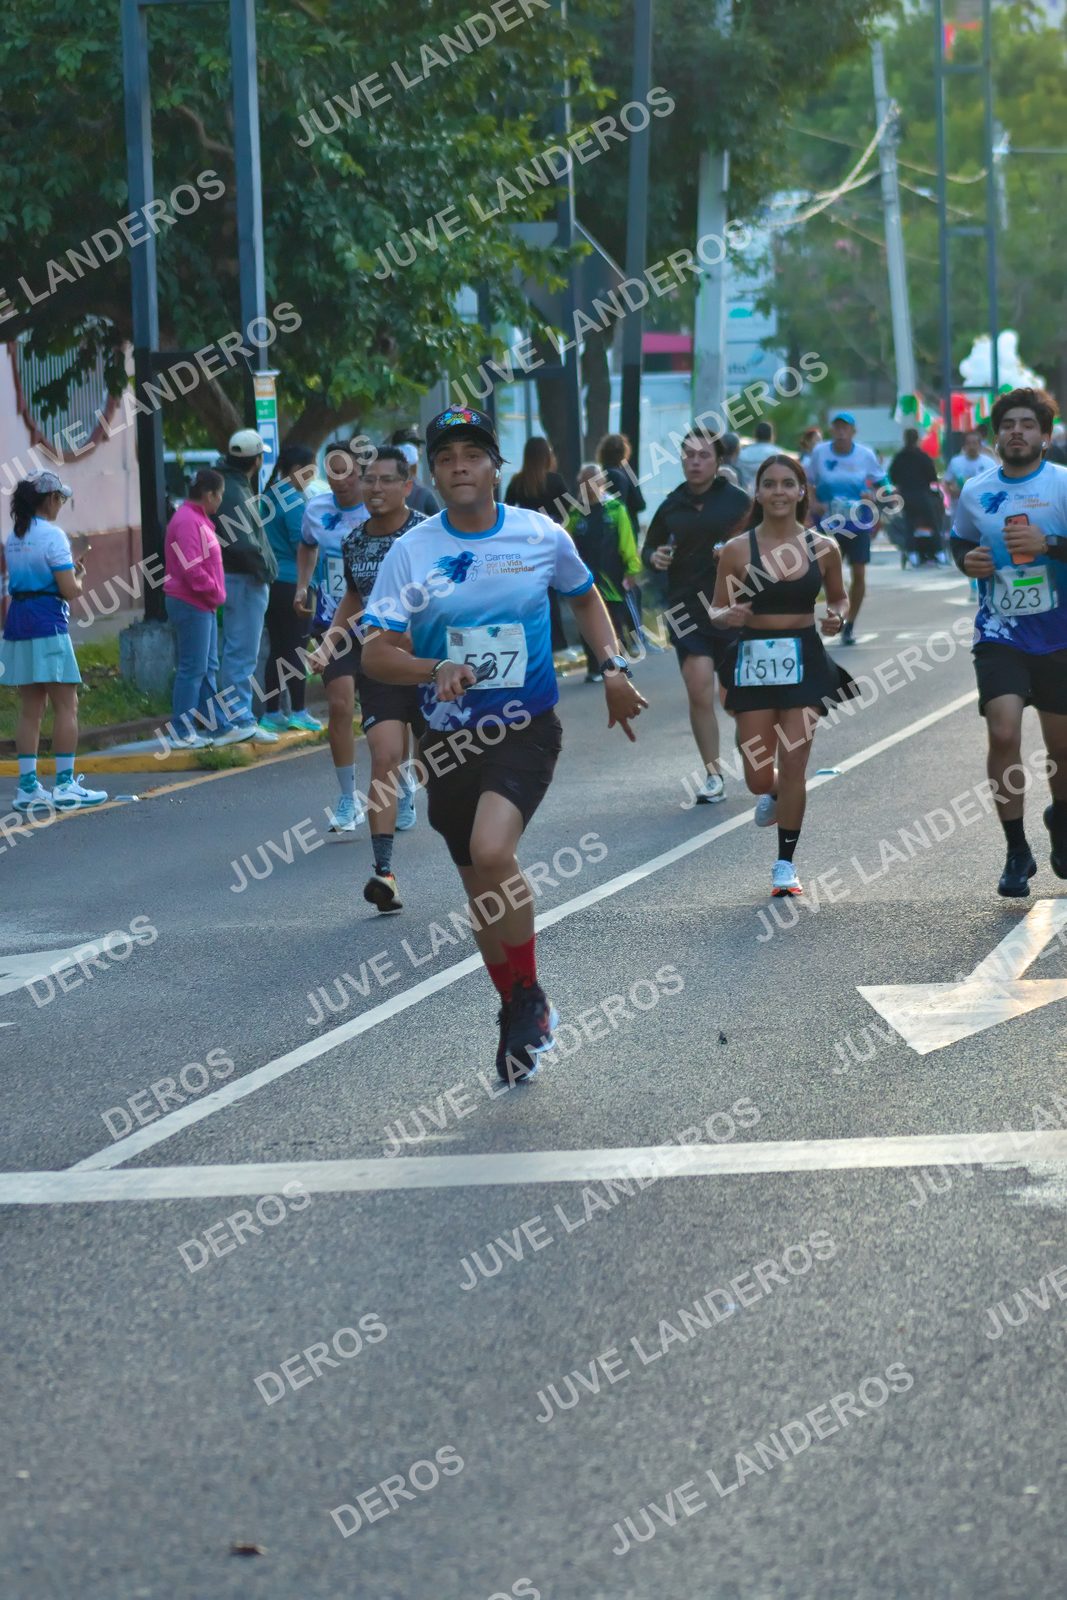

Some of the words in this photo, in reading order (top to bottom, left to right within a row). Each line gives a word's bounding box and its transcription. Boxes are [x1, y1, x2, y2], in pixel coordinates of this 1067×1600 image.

[484, 553, 521, 562] Carrera
[1000, 587, 1042, 610] 623
[745, 657, 796, 680] 1519
